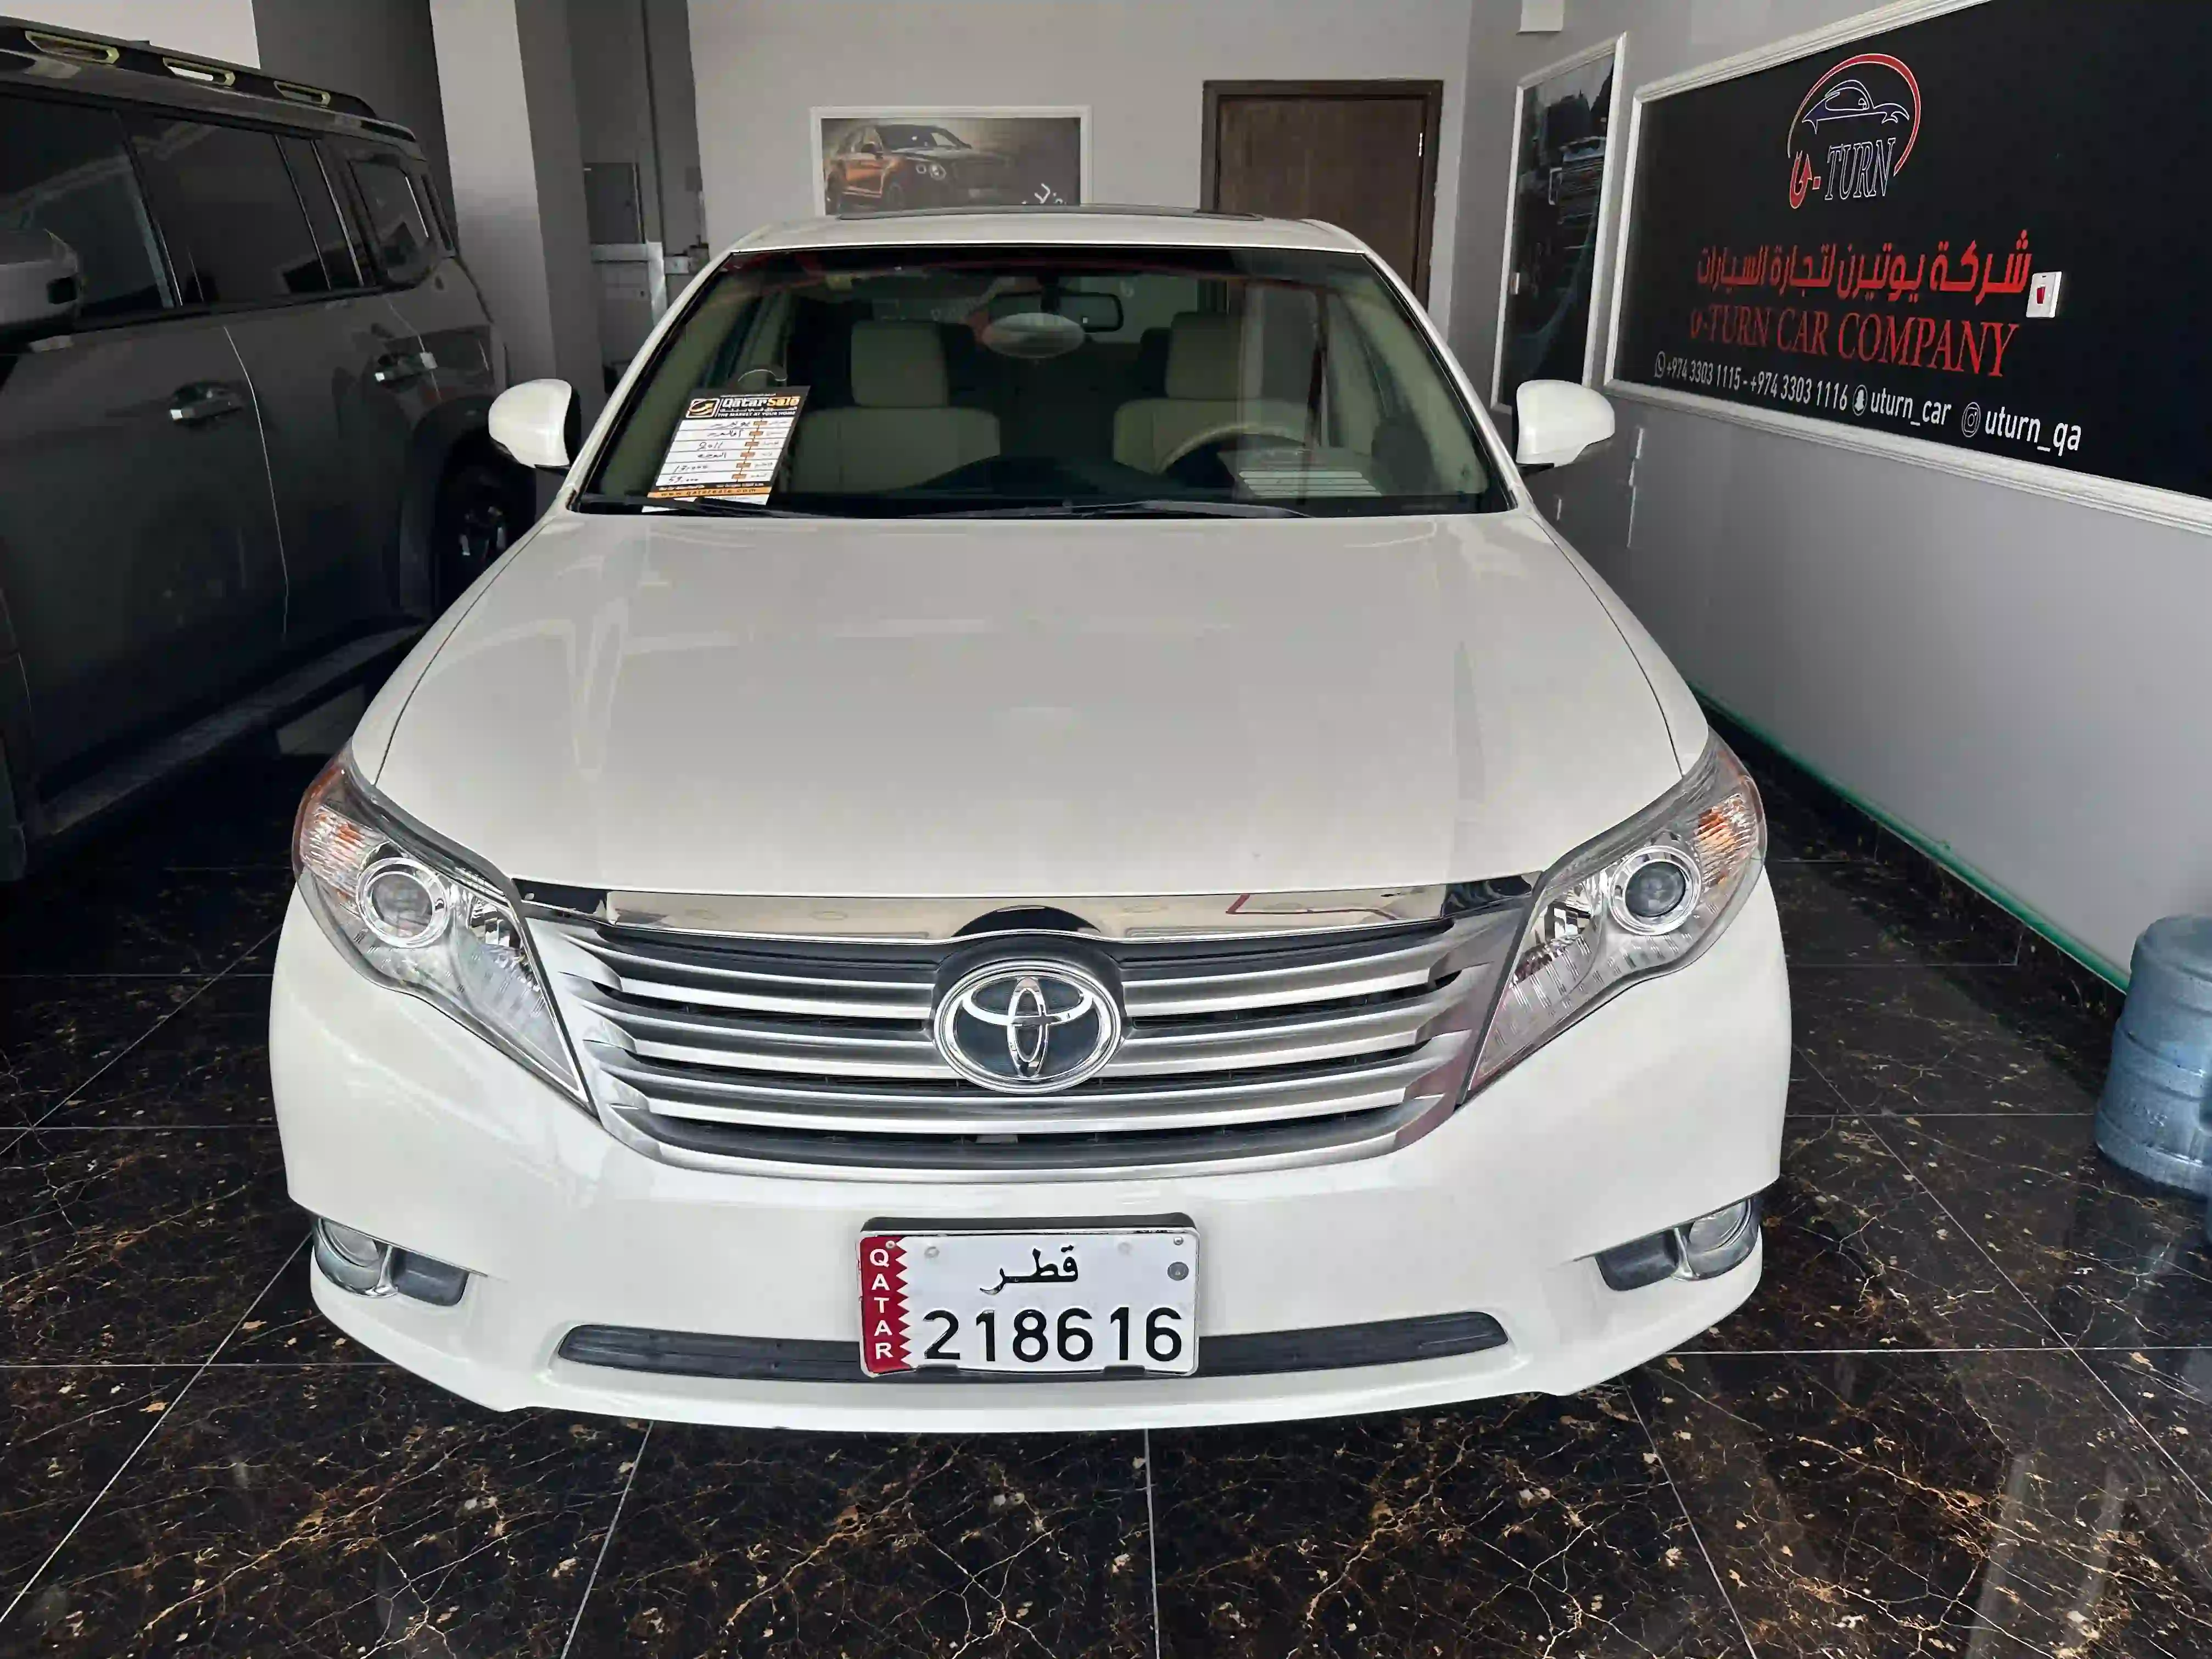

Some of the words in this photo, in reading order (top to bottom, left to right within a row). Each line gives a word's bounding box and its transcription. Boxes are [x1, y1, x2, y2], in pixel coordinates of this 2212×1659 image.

[1697, 245, 1768, 293] السيارات
[1769, 243, 1836, 297] لتجارة
[1837, 243, 1925, 303] يوتيرن
[1930, 229, 2032, 305] شركة
[1777, 308, 1829, 356] CAR
[1839, 312, 2019, 377] COMPANY
[1667, 358, 1688, 381] +974
[1690, 360, 1713, 384] 3303
[1717, 364, 1742, 390] 1115
[1750, 371, 1779, 398] +974
[1780, 375, 1812, 404] 3303
[1816, 380, 1848, 411] 1116
[1870, 387, 1952, 426] uturn_car
[1985, 406, 2081, 456] uturn_qa
[979, 1244, 1079, 1295] قطر
[869, 1248, 893, 1360] QATAR
[923, 1306, 1183, 1362] 218616
